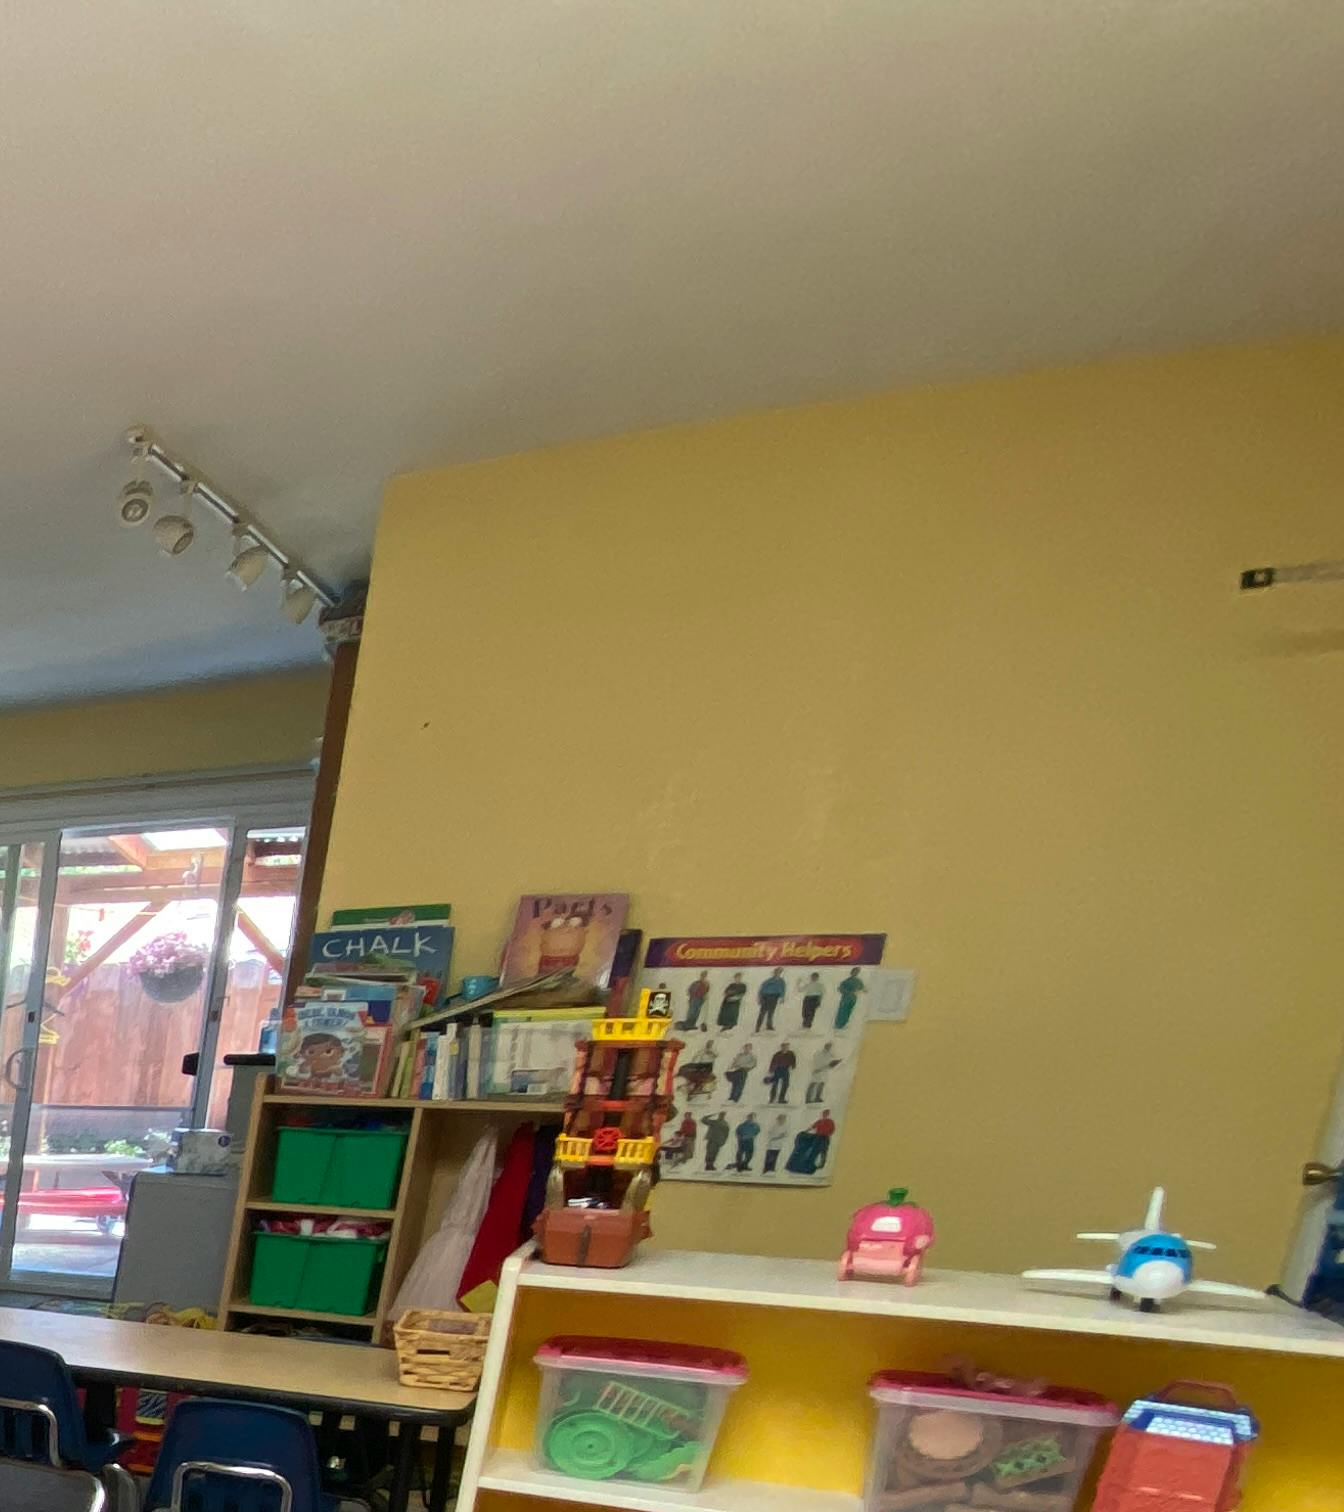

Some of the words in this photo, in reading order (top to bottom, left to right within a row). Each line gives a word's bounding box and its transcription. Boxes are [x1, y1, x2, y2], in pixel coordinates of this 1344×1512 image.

[321, 931, 436, 958] CHALK
[676, 942, 778, 961] Community
[783, 941, 852, 962] Helpers
